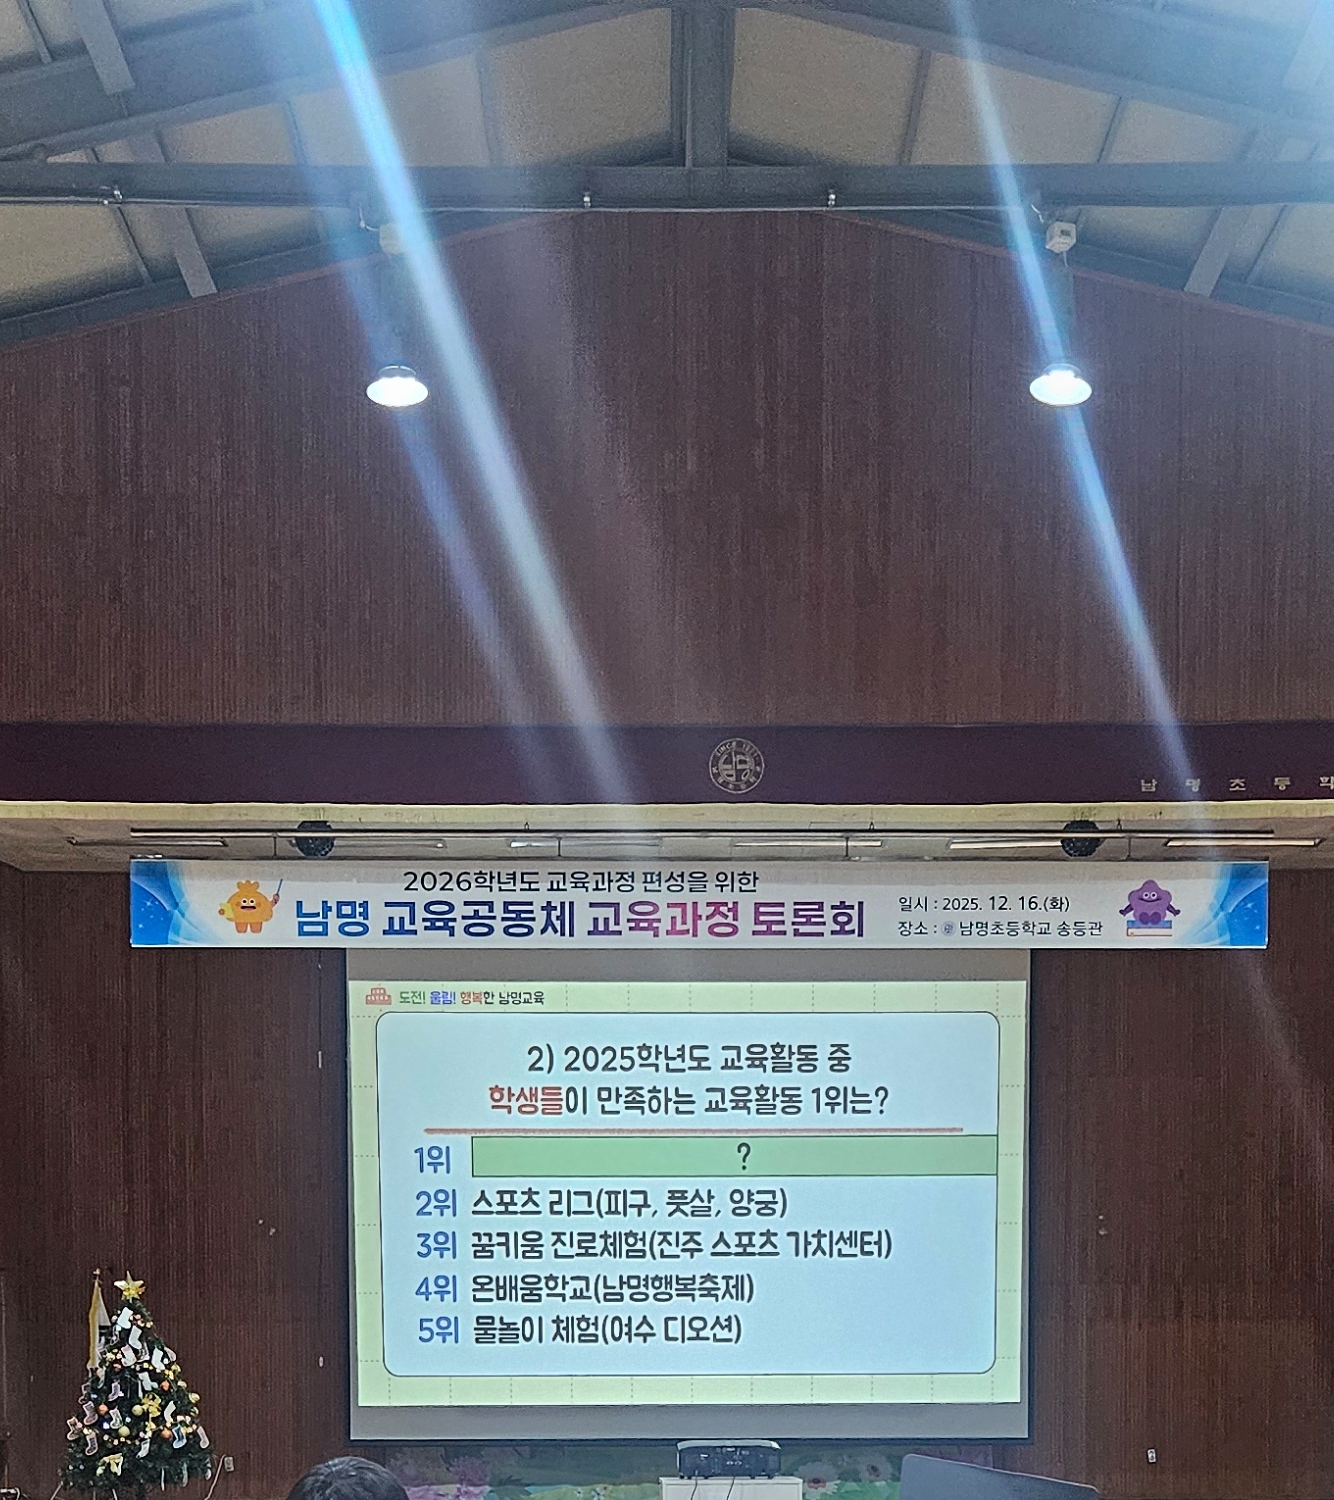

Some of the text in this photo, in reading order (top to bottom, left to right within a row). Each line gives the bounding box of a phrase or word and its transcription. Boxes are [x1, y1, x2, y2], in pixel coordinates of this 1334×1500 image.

[402, 870, 760, 893] 2026학년도 교육과정 편성을 위한
[296, 900, 865, 938] 남명 교육공동체 교육과정 토론회
[898, 896, 928, 912] 일시
[942, 897, 983, 911] 2025.
[988, 895, 1012, 911] 12.
[1018, 895, 1070, 912] 16.(화)
[898, 921, 929, 937] 장소
[959, 921, 1052, 937] 남명초등학교
[1056, 921, 1103, 937] 송등관
[398, 990, 426, 1004] 도전!
[460, 990, 495, 1005] 행복한
[499, 990, 545, 1005] 남명교육
[527, 1042, 852, 1074] 2) 2025학년도 교육활동 중
[488, 1084, 889, 1116] 학생들이 만족하는 교육활동 1위는?
[414, 1142, 752, 1174] 1위 ?
[415, 1187, 788, 1219] 2위 스포츠 리그(피구, 풋살, 양궁)
[416, 1229, 893, 1261] 3위 꿈키움 진로체험(진주 스포츠 가치센터)
[415, 1273, 755, 1303] 4위 온배움학교(남명행복축제)
[418, 1314, 743, 1345] 5위 물놀이 체험(여수 디오션)
